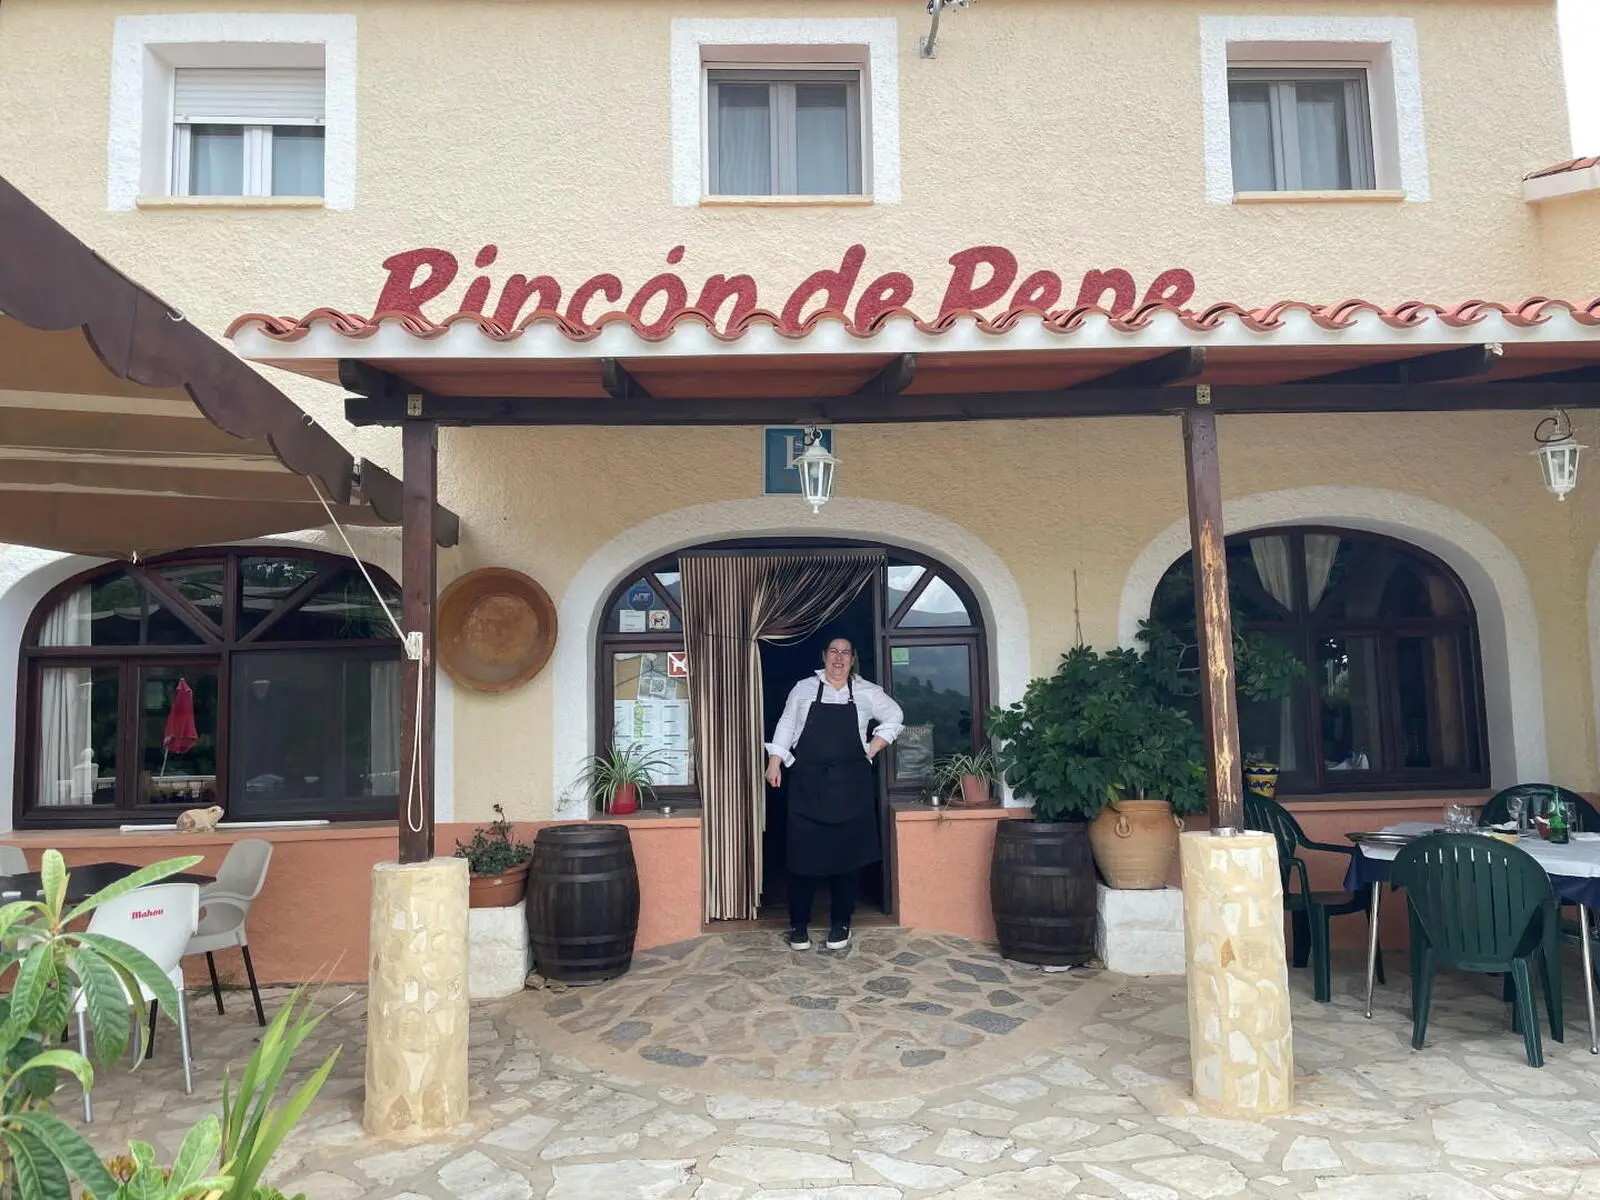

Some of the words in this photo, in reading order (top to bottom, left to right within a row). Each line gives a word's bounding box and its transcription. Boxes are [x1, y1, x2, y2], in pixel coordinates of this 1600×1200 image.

[374, 244, 758, 335] Rincón
[779, 243, 914, 331] de
[132, 908, 164, 920] Mahou
